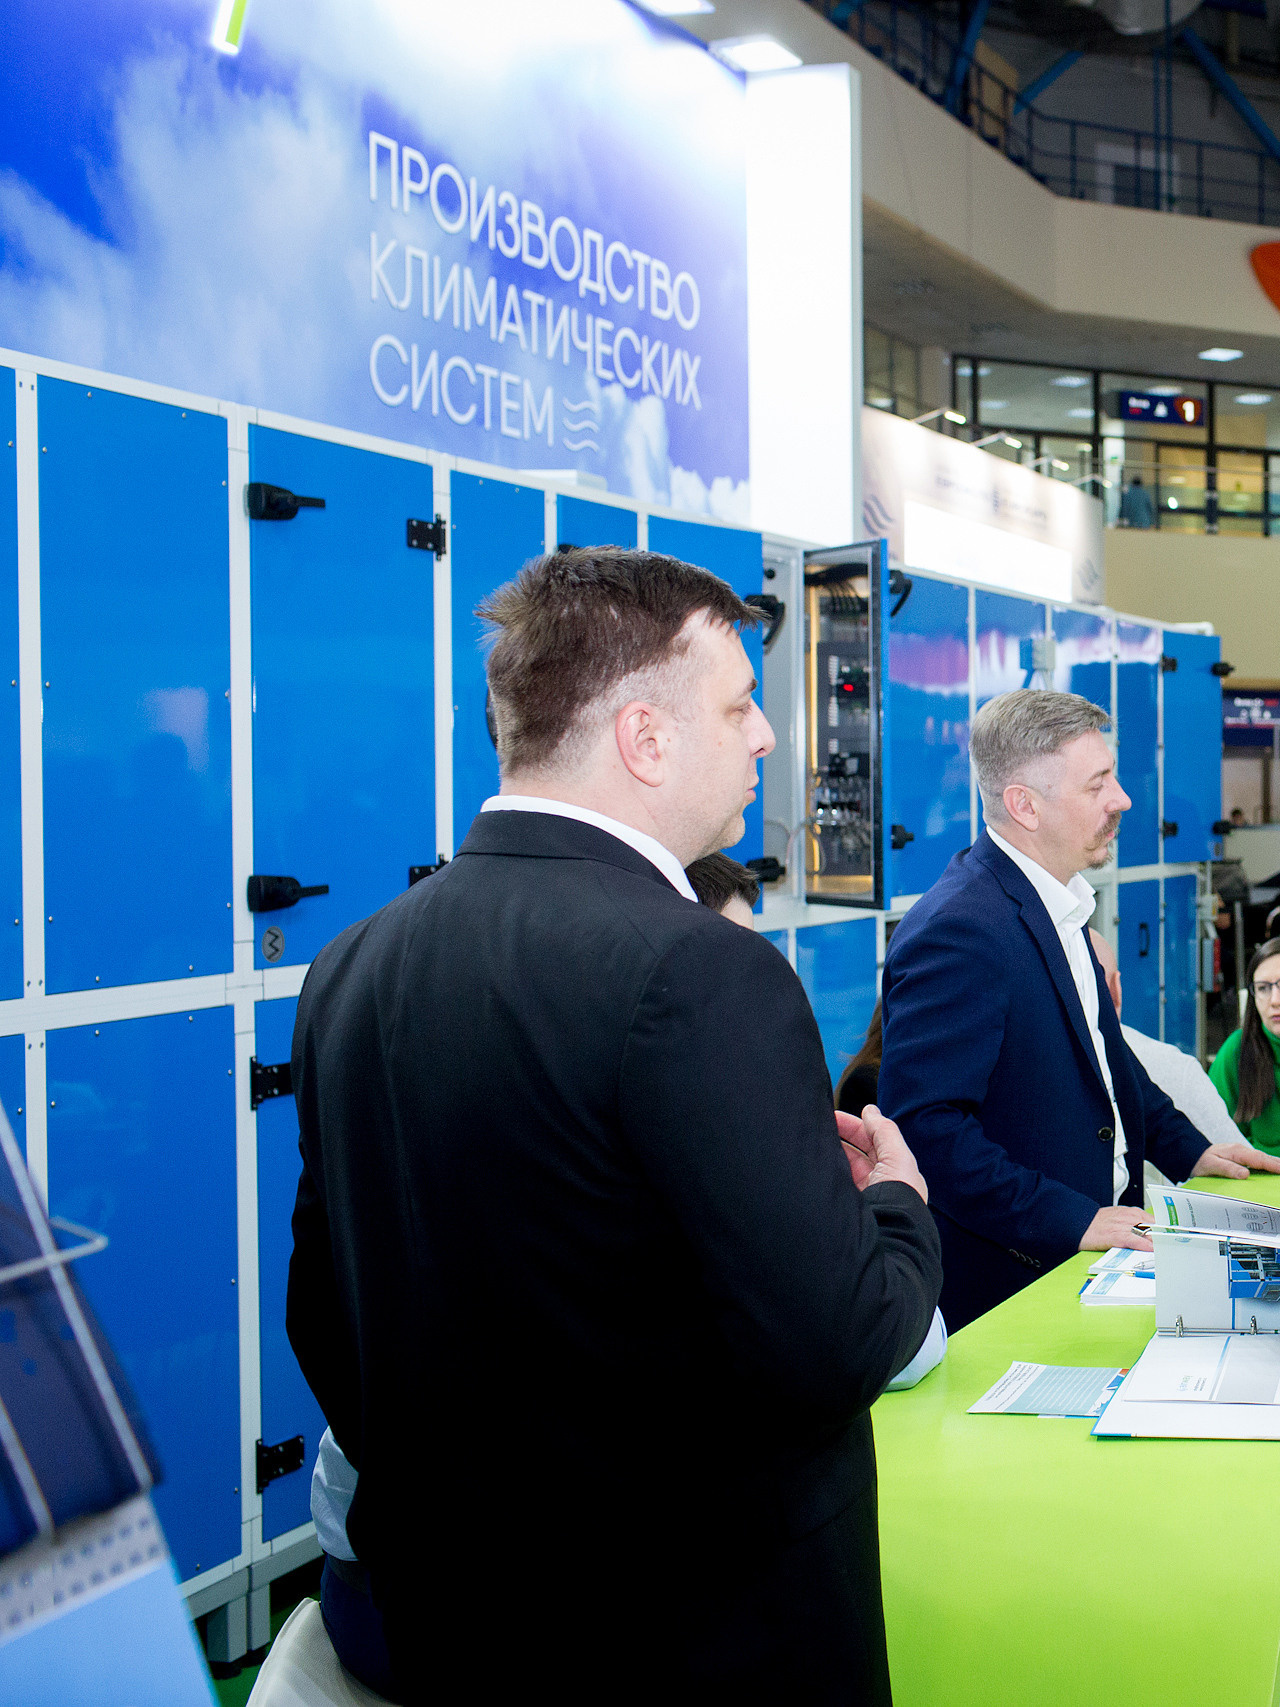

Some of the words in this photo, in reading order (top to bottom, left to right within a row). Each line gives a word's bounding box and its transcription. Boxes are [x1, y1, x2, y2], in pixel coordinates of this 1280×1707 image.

[369, 130, 701, 331] ПРОИЗВОДСТВО
[369, 334, 554, 447] СИСТЕМ
[370, 231, 702, 411] КЛИМАТИЧЕСКИХ
[1182, 400, 1195, 422] 1
